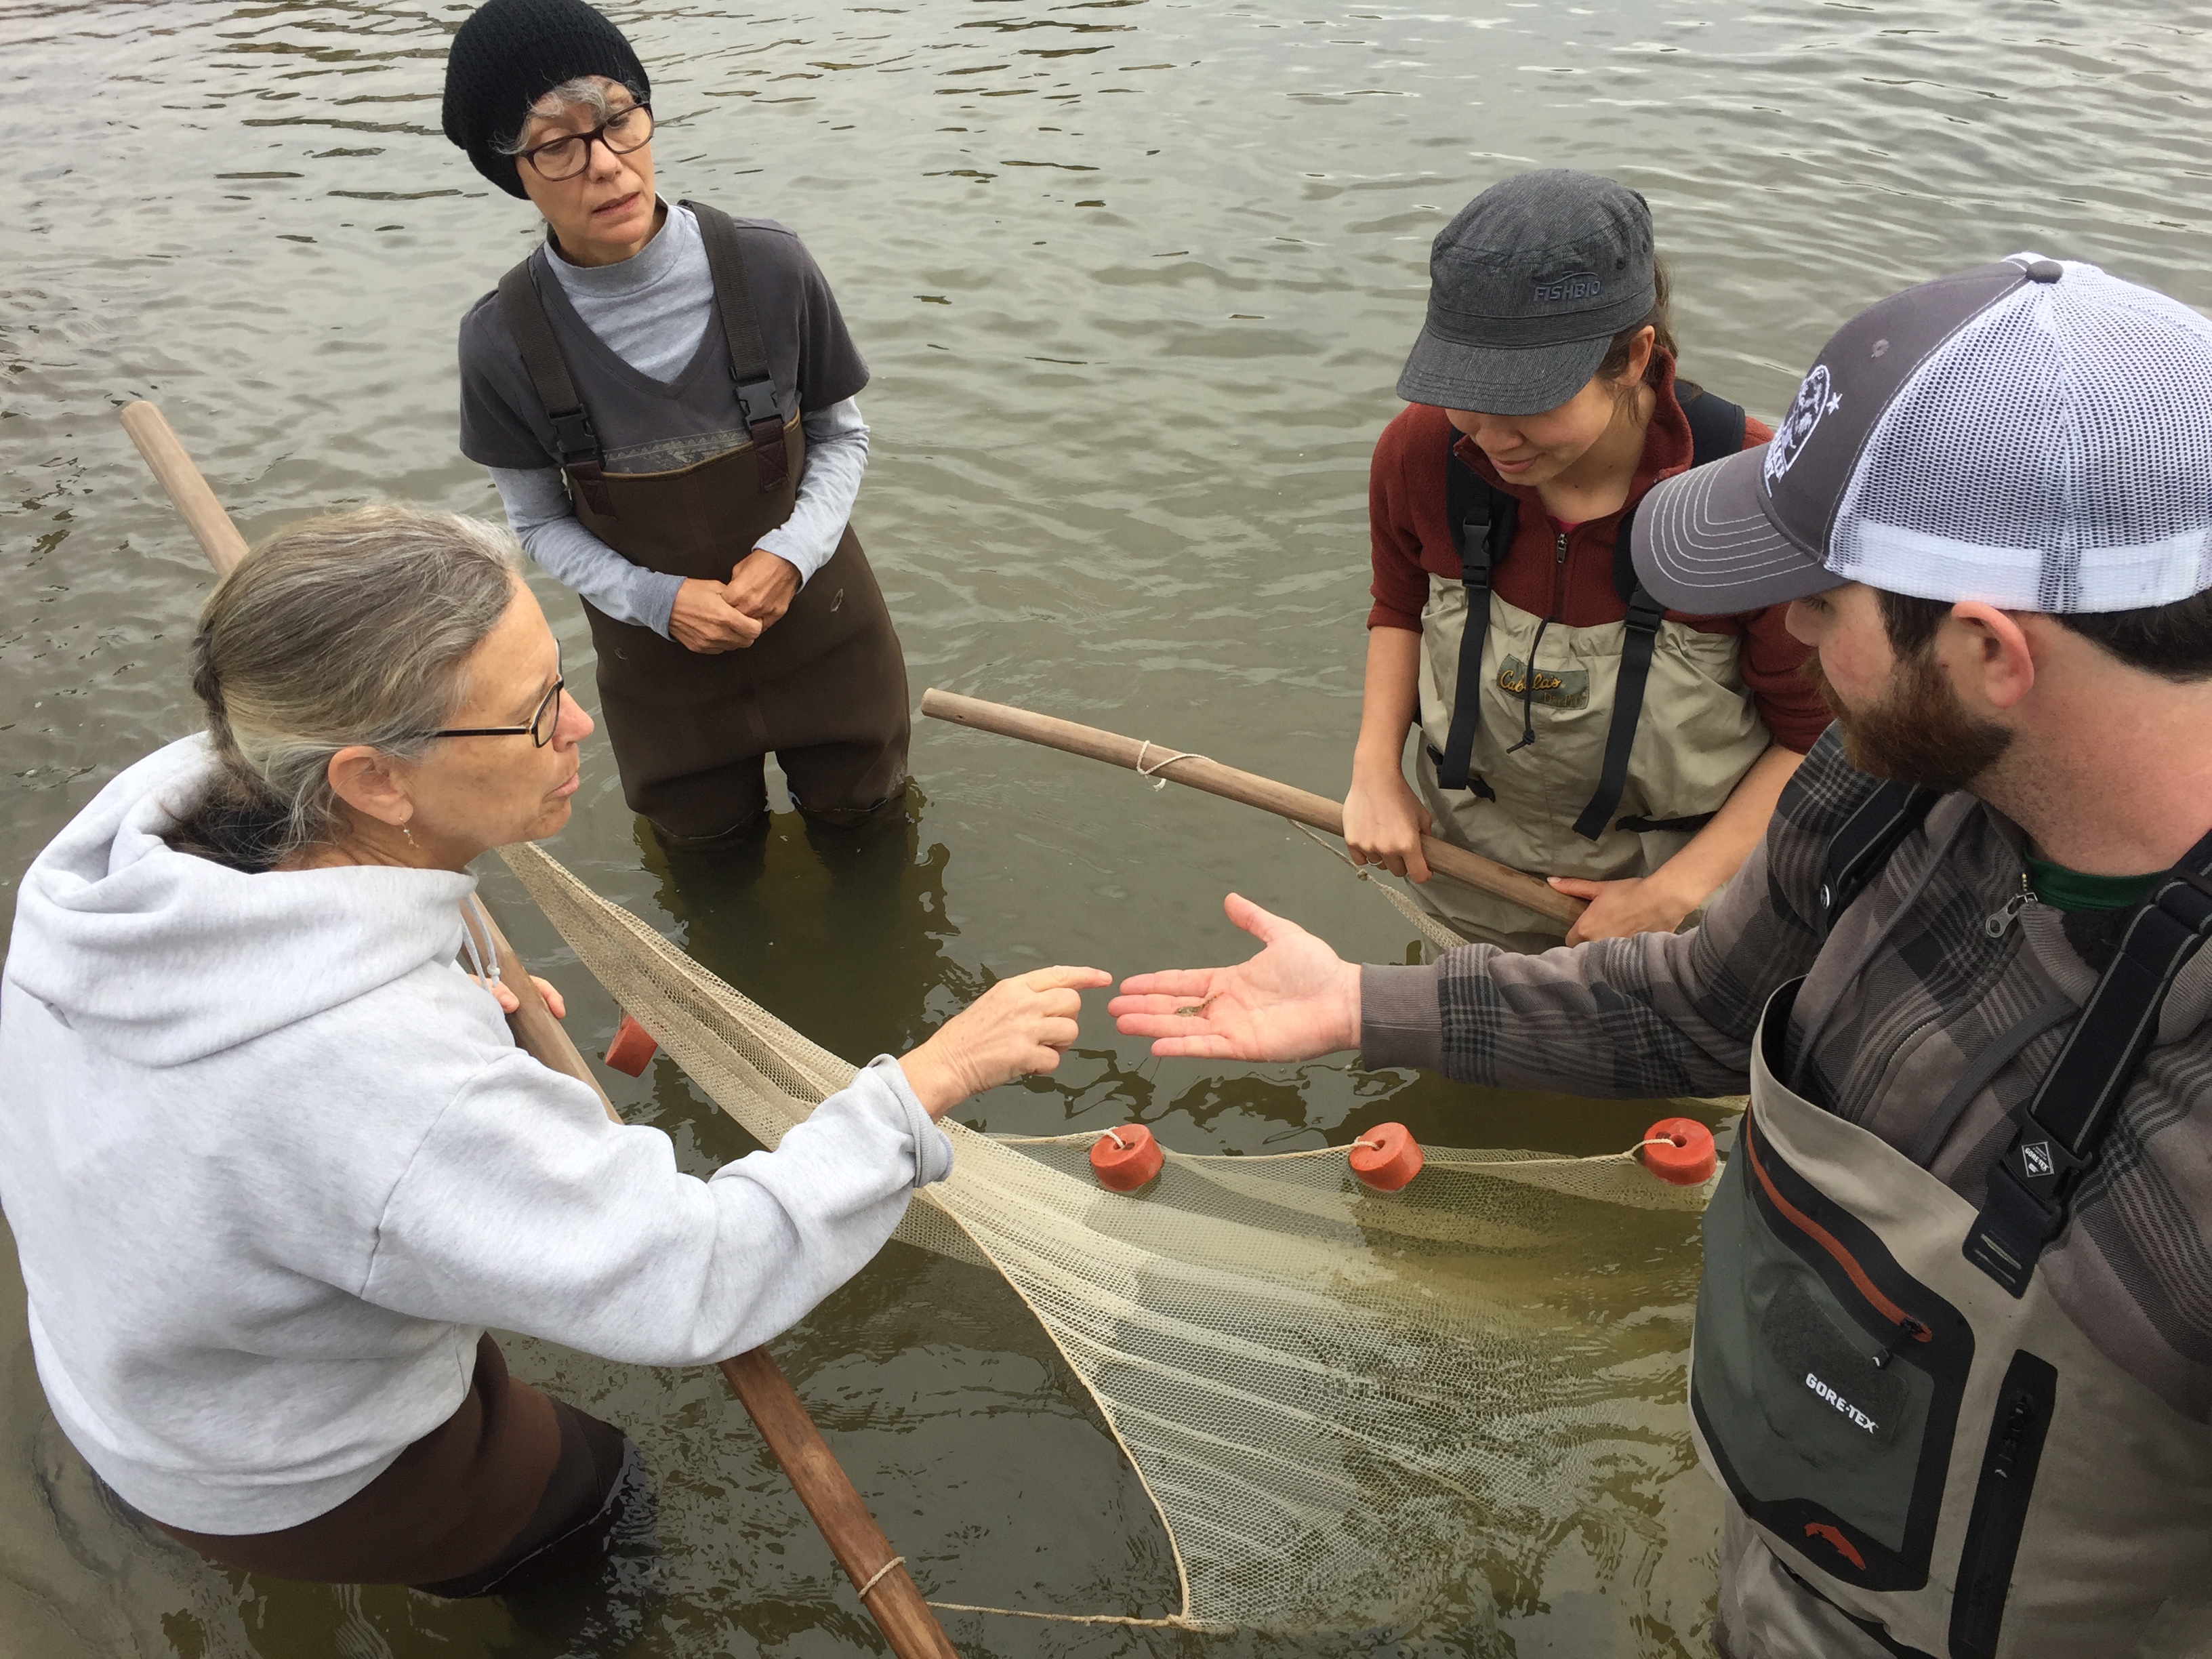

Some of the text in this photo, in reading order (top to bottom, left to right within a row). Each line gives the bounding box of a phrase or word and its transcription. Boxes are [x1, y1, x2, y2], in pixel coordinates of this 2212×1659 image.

[1534, 281, 1601, 301] FISHBIO
[1500, 670, 1561, 693] Cabla's
[1805, 1372, 1876, 1434] GORE-TEX
